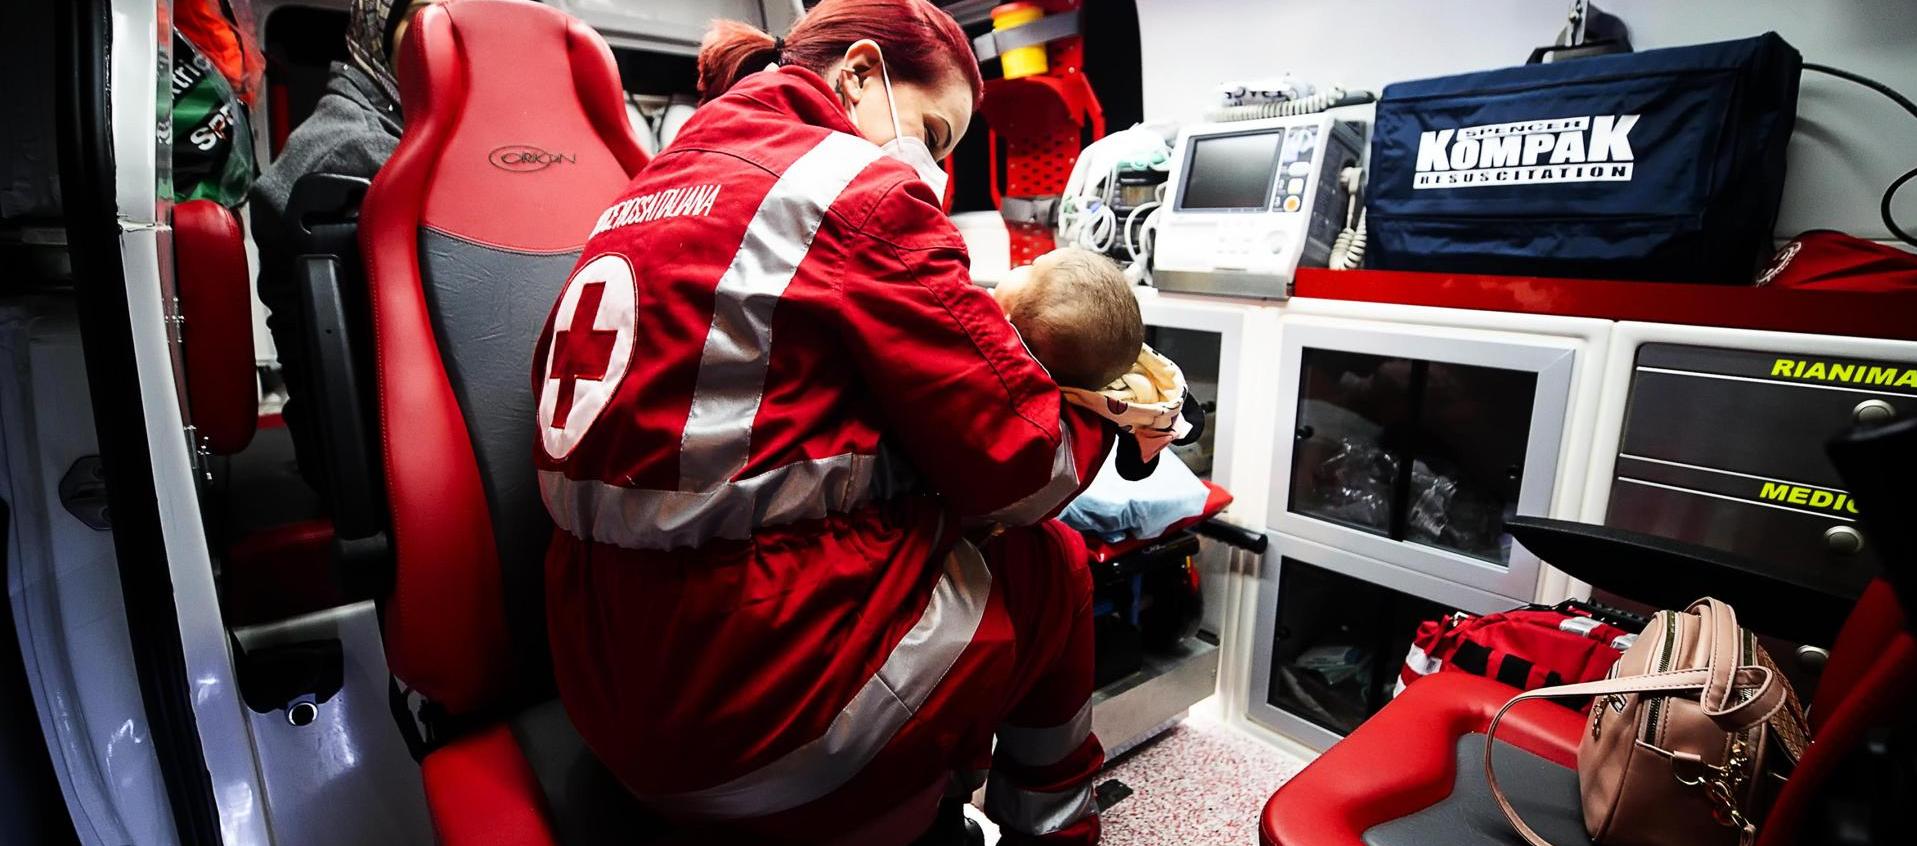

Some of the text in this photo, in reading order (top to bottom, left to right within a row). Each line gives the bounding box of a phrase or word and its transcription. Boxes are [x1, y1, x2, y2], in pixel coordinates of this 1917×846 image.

[1465, 119, 1582, 138] SPENCER
[1419, 165, 1628, 185] RESUSCITATION
[1771, 359, 1917, 388] RIANIMA
